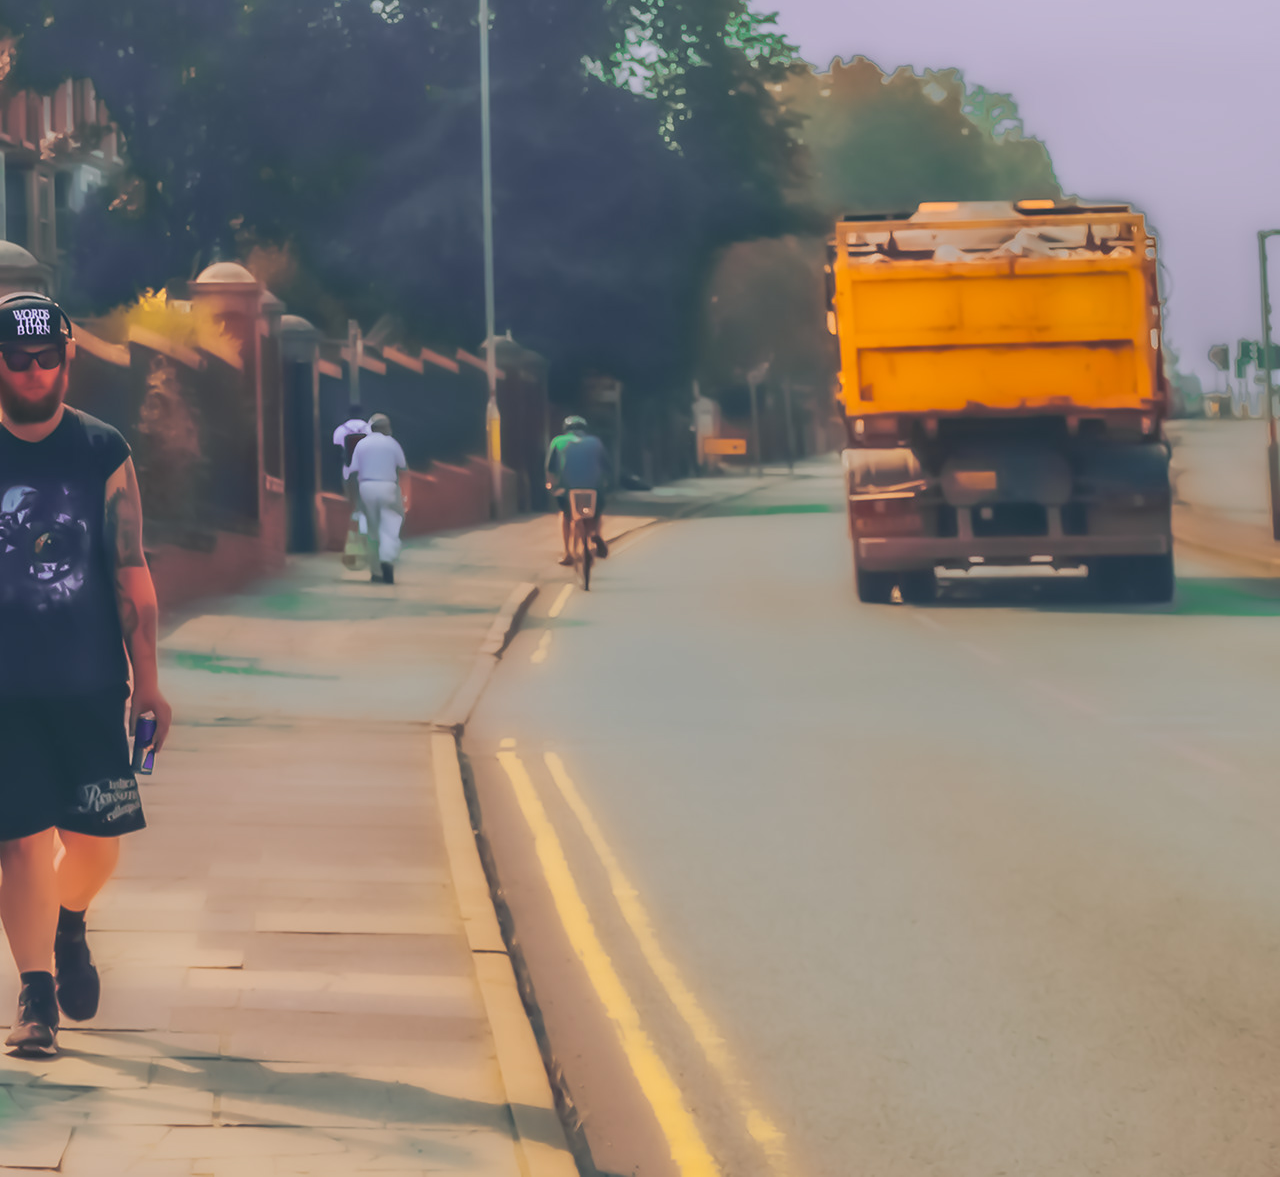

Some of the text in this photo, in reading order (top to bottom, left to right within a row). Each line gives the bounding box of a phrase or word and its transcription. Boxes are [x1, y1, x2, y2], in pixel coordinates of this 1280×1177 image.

[12, 308, 51, 321] WORDS
[18, 317, 49, 328] THAT
[17, 325, 51, 336] BURN
